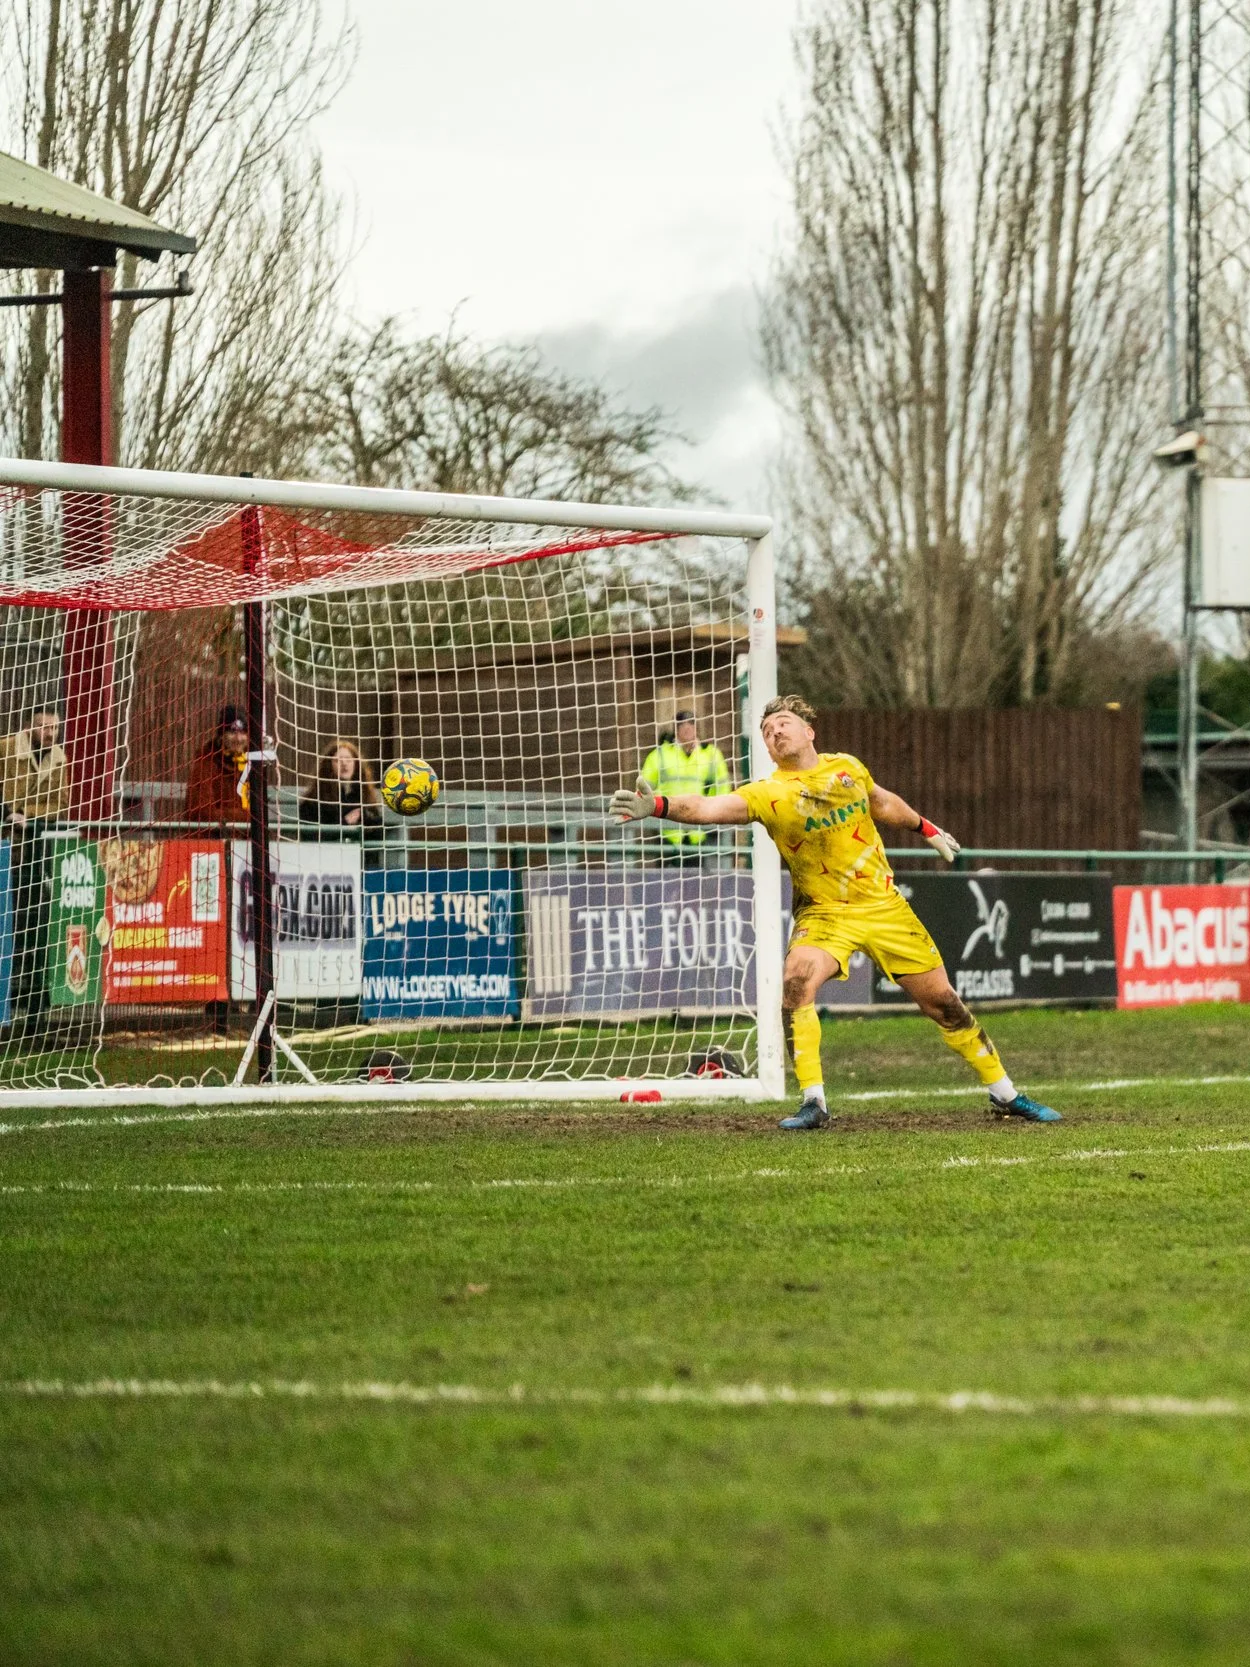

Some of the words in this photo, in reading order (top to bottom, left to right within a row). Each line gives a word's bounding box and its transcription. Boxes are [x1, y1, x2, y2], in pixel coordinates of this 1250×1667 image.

[371, 893, 436, 936] LODGE
[442, 893, 489, 935] TYRE
[577, 909, 649, 971] THE
[660, 906, 749, 968] FOUR
[1123, 889, 1249, 969] Abacus
[955, 969, 1015, 998] PEGASUS
